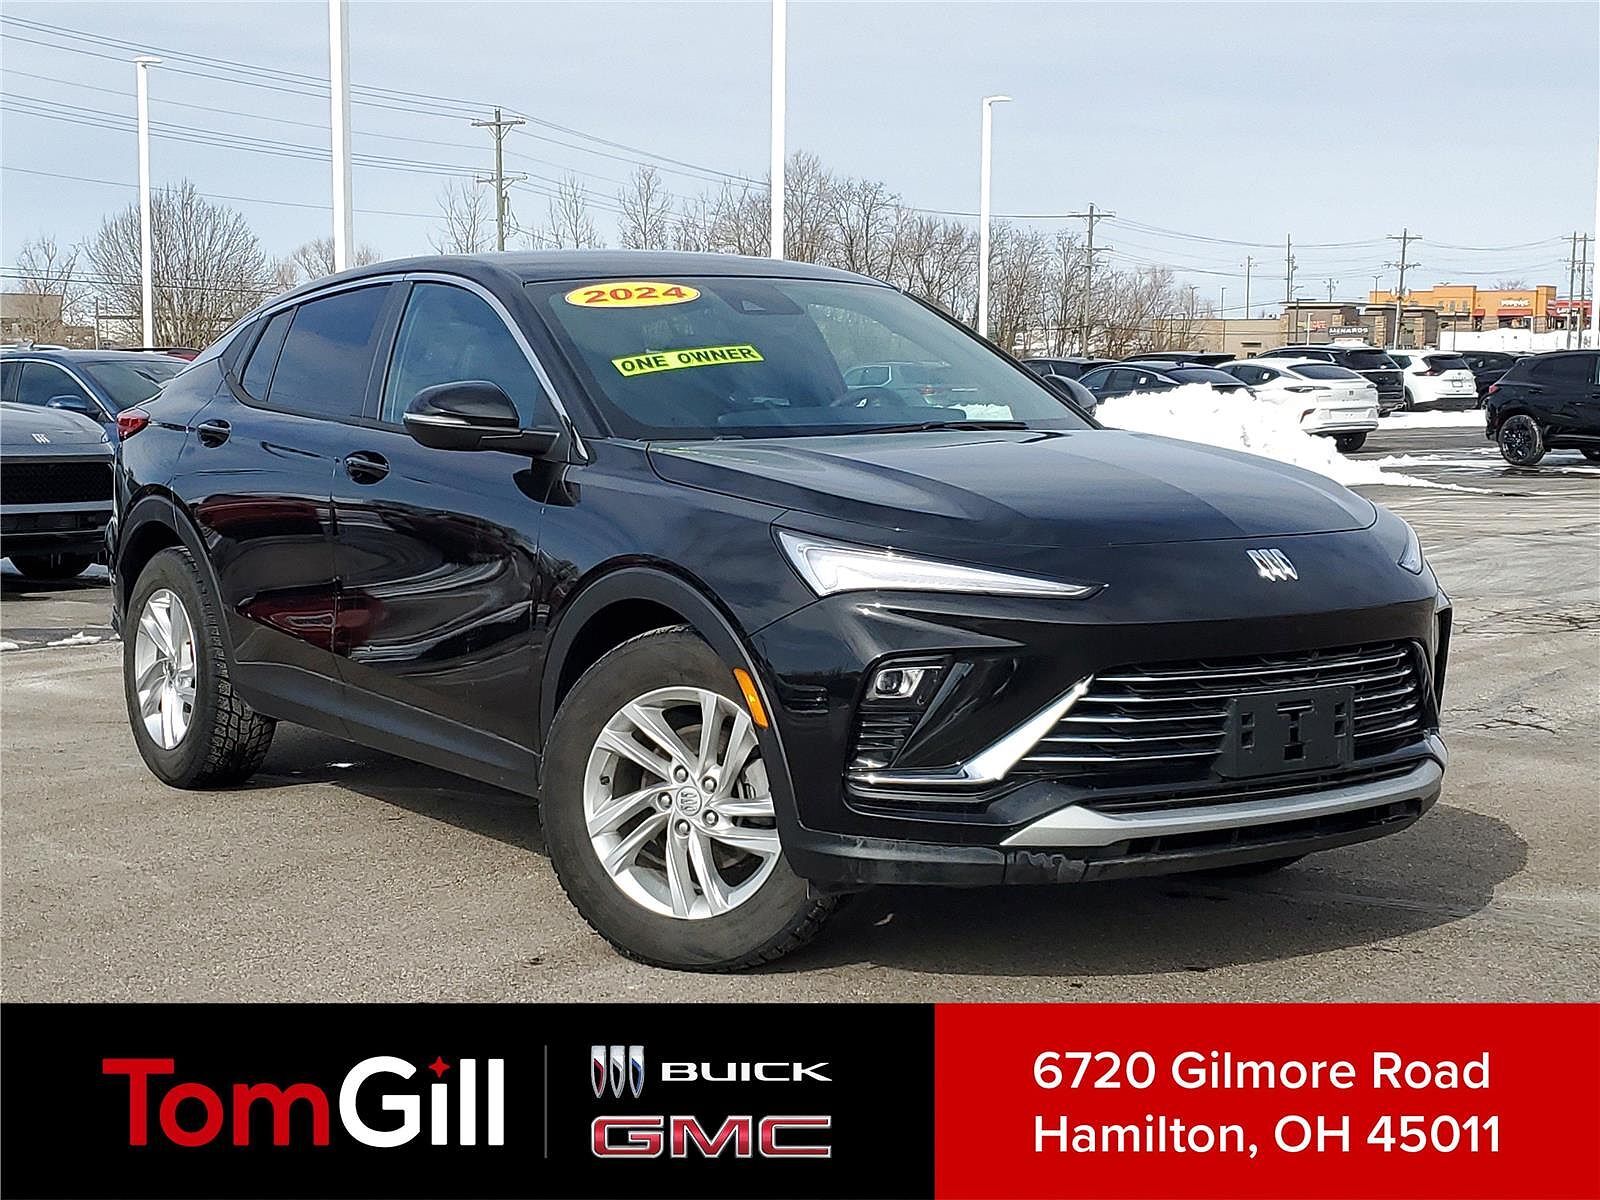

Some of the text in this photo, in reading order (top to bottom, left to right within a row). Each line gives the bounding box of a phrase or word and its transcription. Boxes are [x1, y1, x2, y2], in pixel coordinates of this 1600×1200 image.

[584, 287, 686, 303] 2024
[621, 348, 756, 371] ONE OWNER
